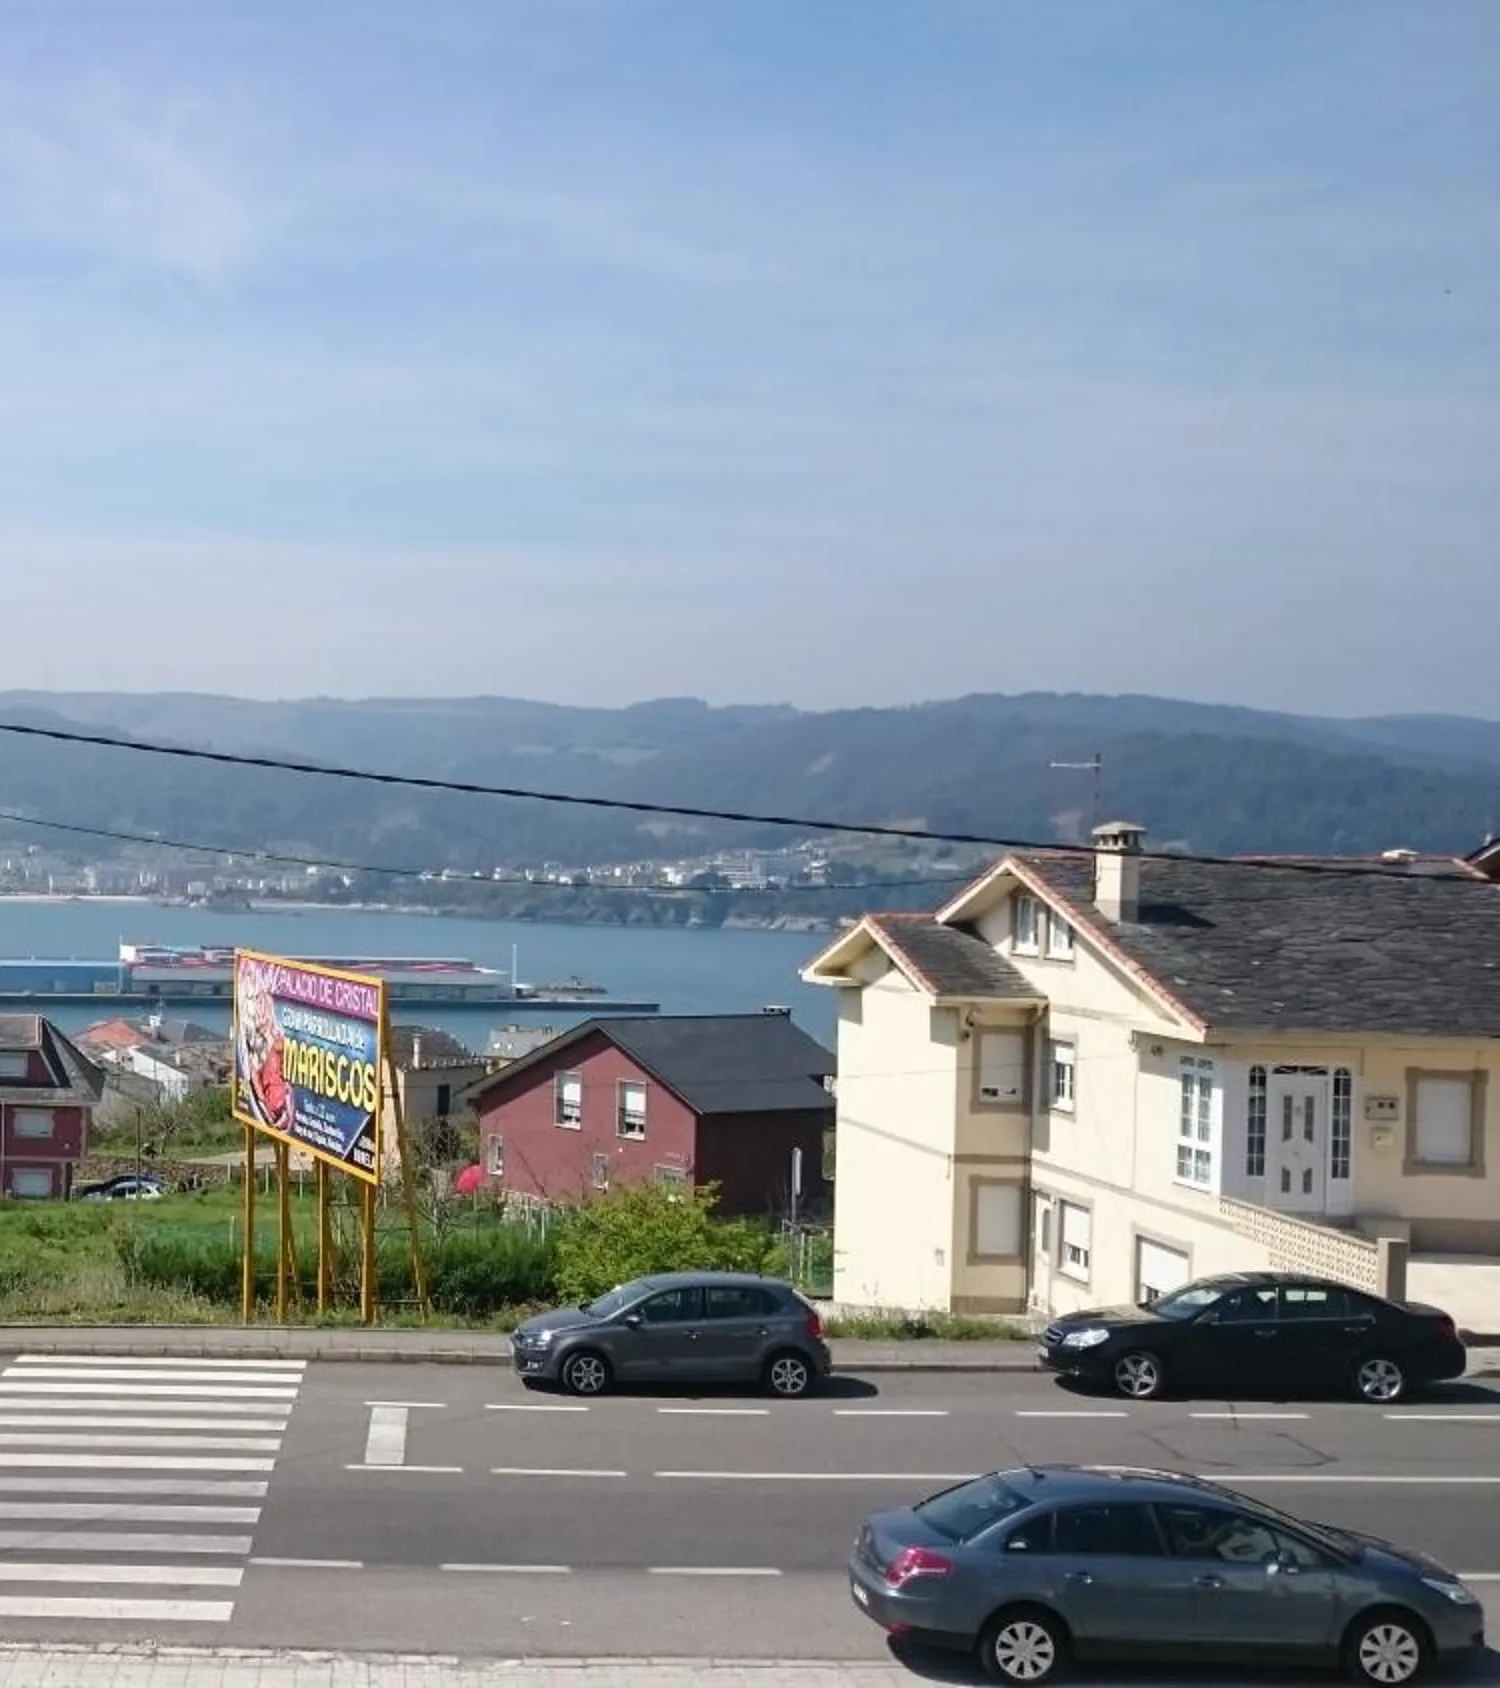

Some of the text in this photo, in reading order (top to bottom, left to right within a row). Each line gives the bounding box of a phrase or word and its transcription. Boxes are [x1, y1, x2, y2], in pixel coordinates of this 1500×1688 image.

[319, 977, 333, 1005] DE
[335, 981, 379, 1017] CRISTAL
[283, 1037, 376, 1113] MARISCOS
